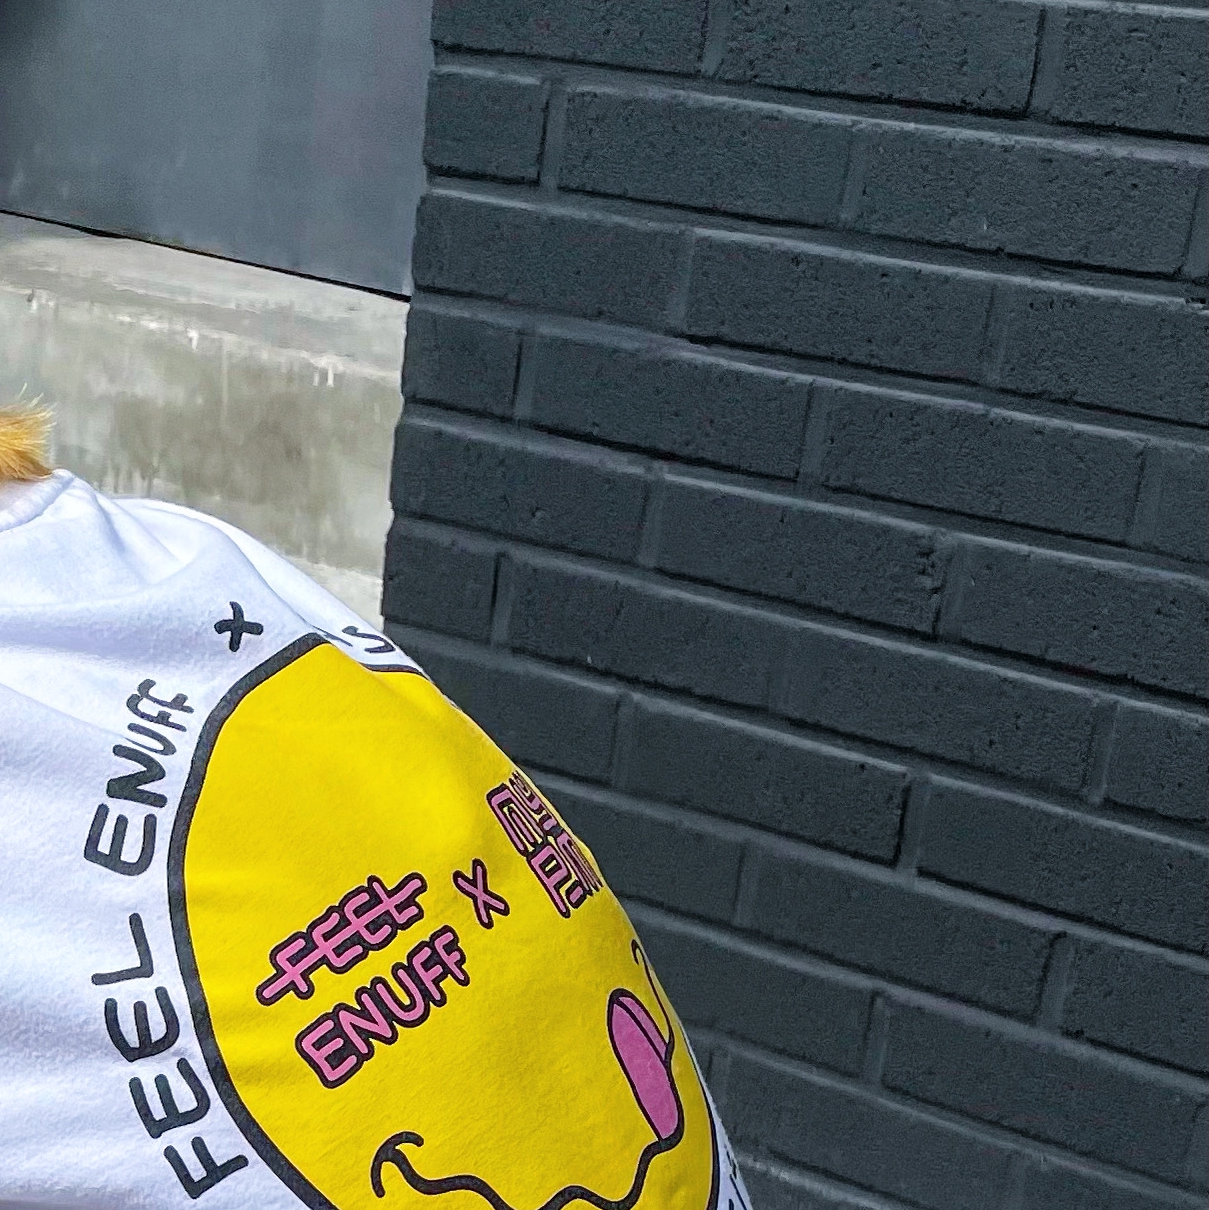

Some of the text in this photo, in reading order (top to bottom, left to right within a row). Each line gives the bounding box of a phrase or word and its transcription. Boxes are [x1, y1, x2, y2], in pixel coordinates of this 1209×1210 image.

[84, 678, 194, 876] ENUFF
[92, 912, 249, 1200] FEEL
[295, 924, 471, 1089] ENUFF
